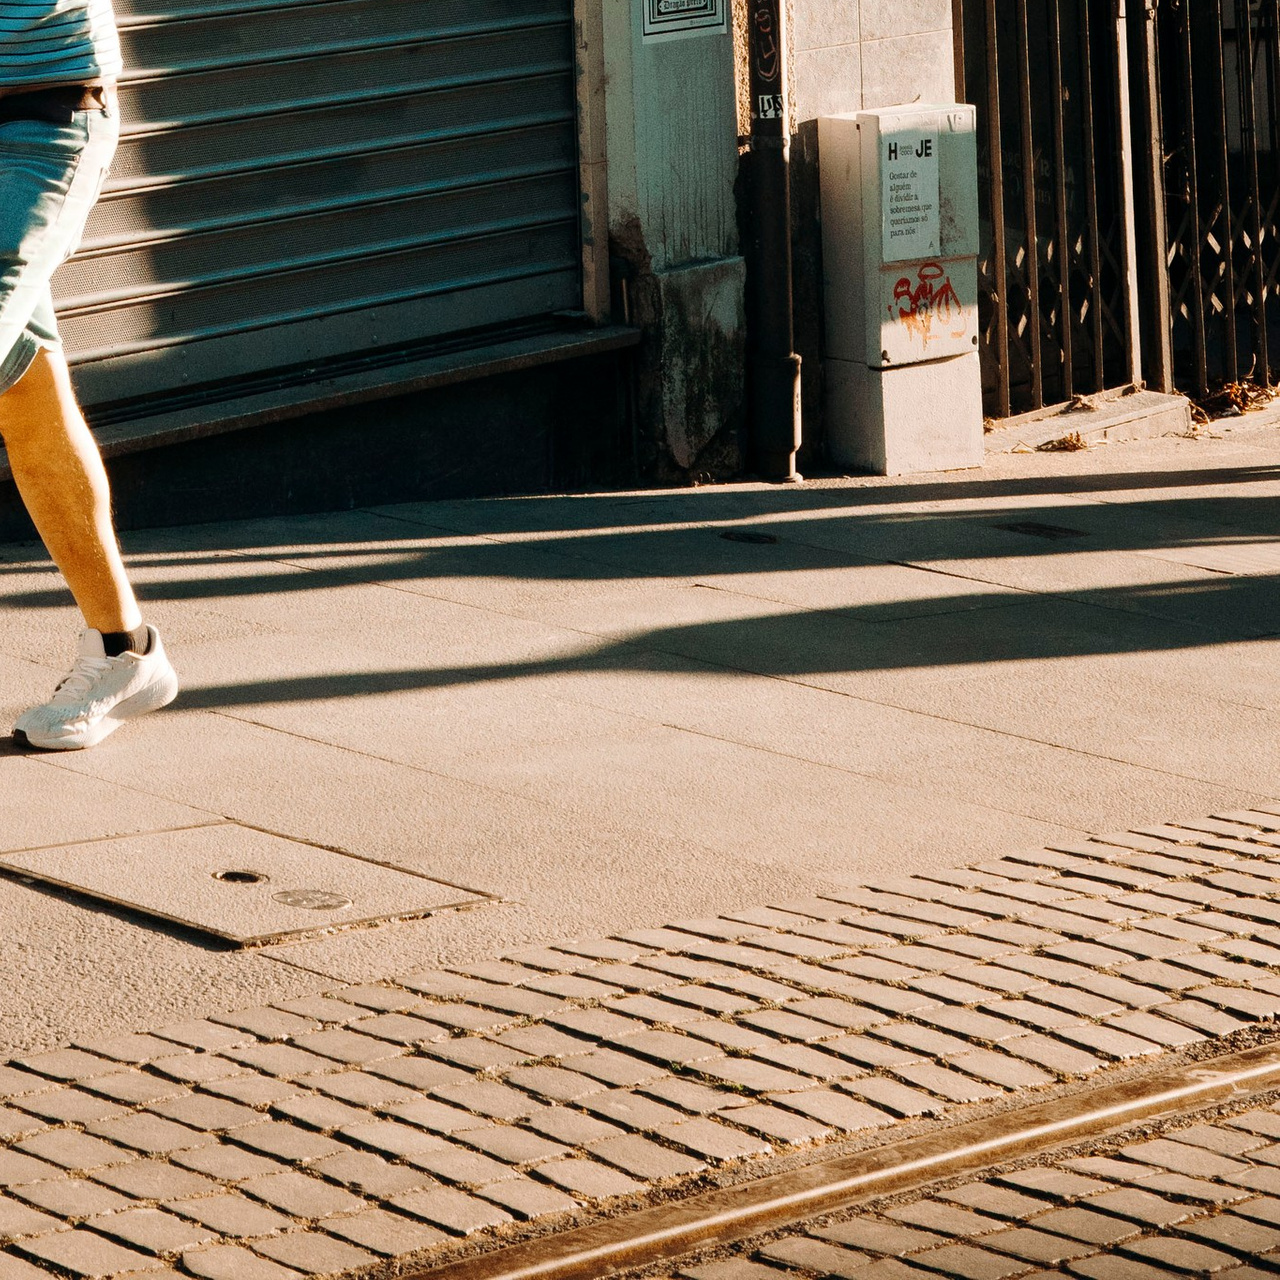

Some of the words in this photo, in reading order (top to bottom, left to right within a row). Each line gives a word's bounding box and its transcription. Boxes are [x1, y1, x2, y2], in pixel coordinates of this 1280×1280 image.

[889, 171, 909, 181] Gostar
[910, 170, 917, 178] de
[890, 182, 911, 193] alguém
[894, 193, 914, 202] dividir
[890, 205, 920, 214] sobremesa
[921, 203, 932, 212] que
[890, 230, 904, 239] para
